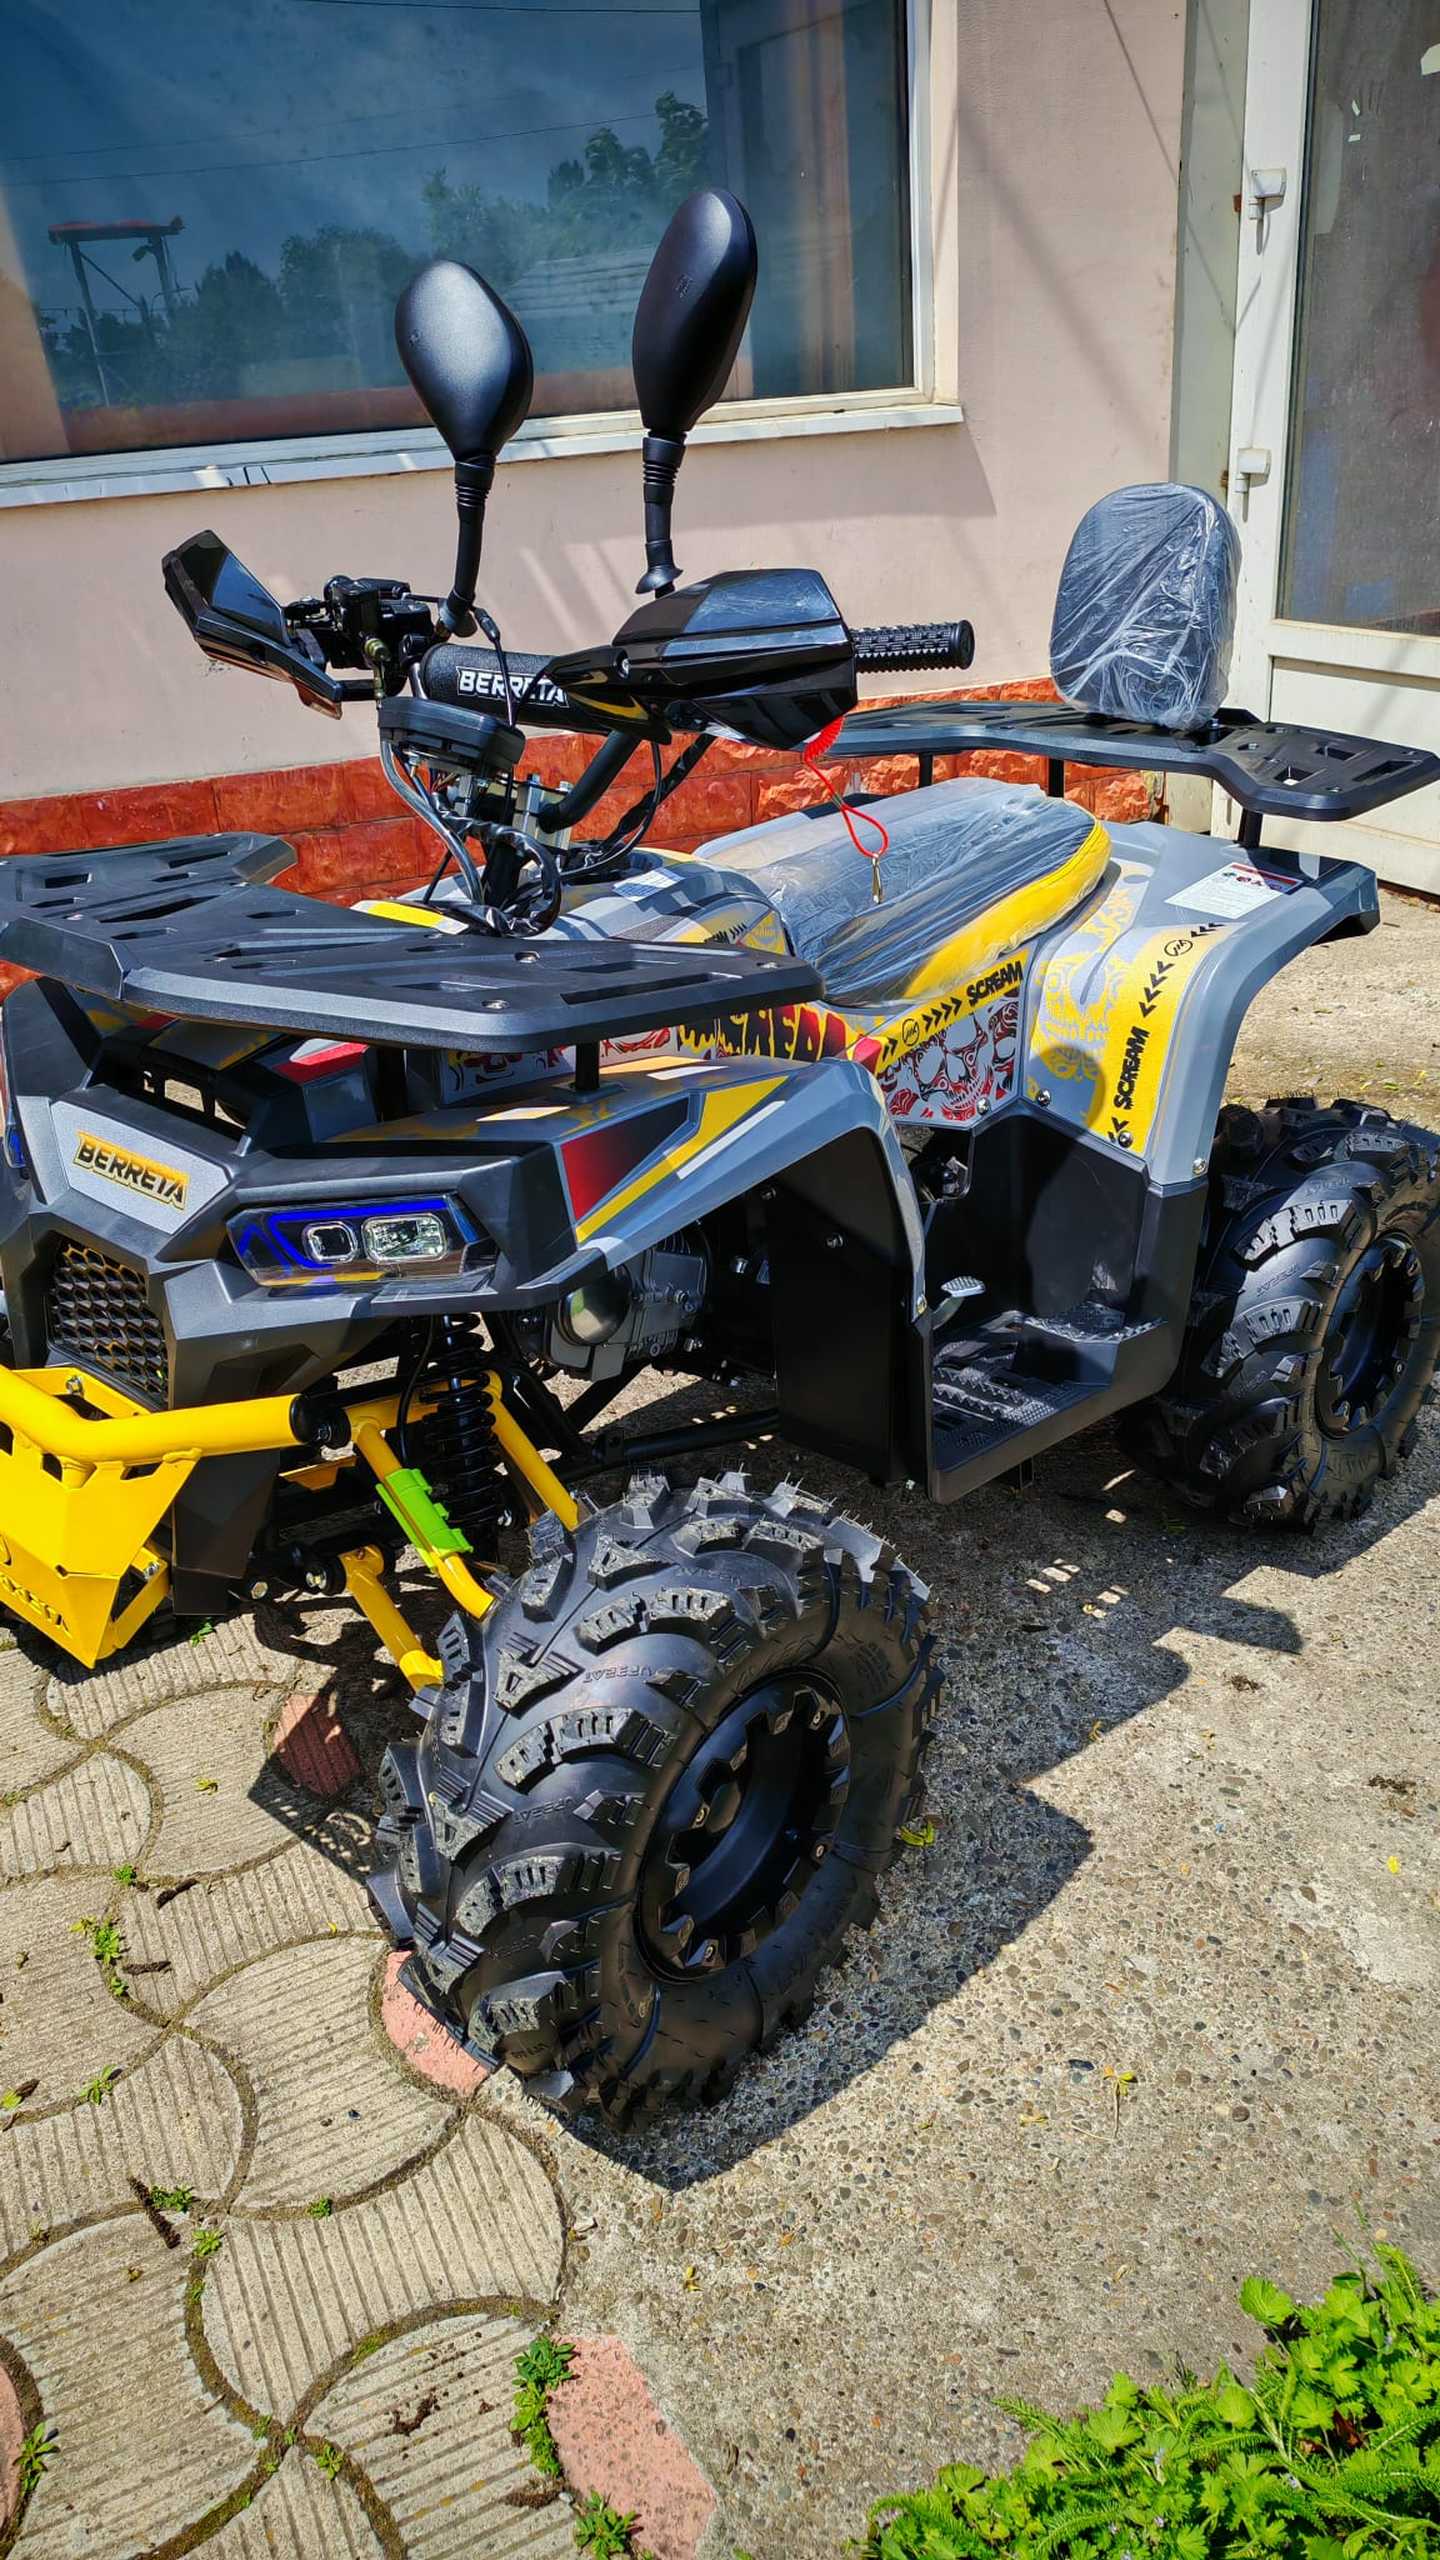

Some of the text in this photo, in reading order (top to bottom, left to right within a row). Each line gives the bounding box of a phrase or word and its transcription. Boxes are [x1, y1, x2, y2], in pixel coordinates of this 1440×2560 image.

[967, 960, 1024, 1006] SCREAM
[1113, 1026, 1151, 1110] SCREAM
[77, 1143, 185, 1204] BERRETA
